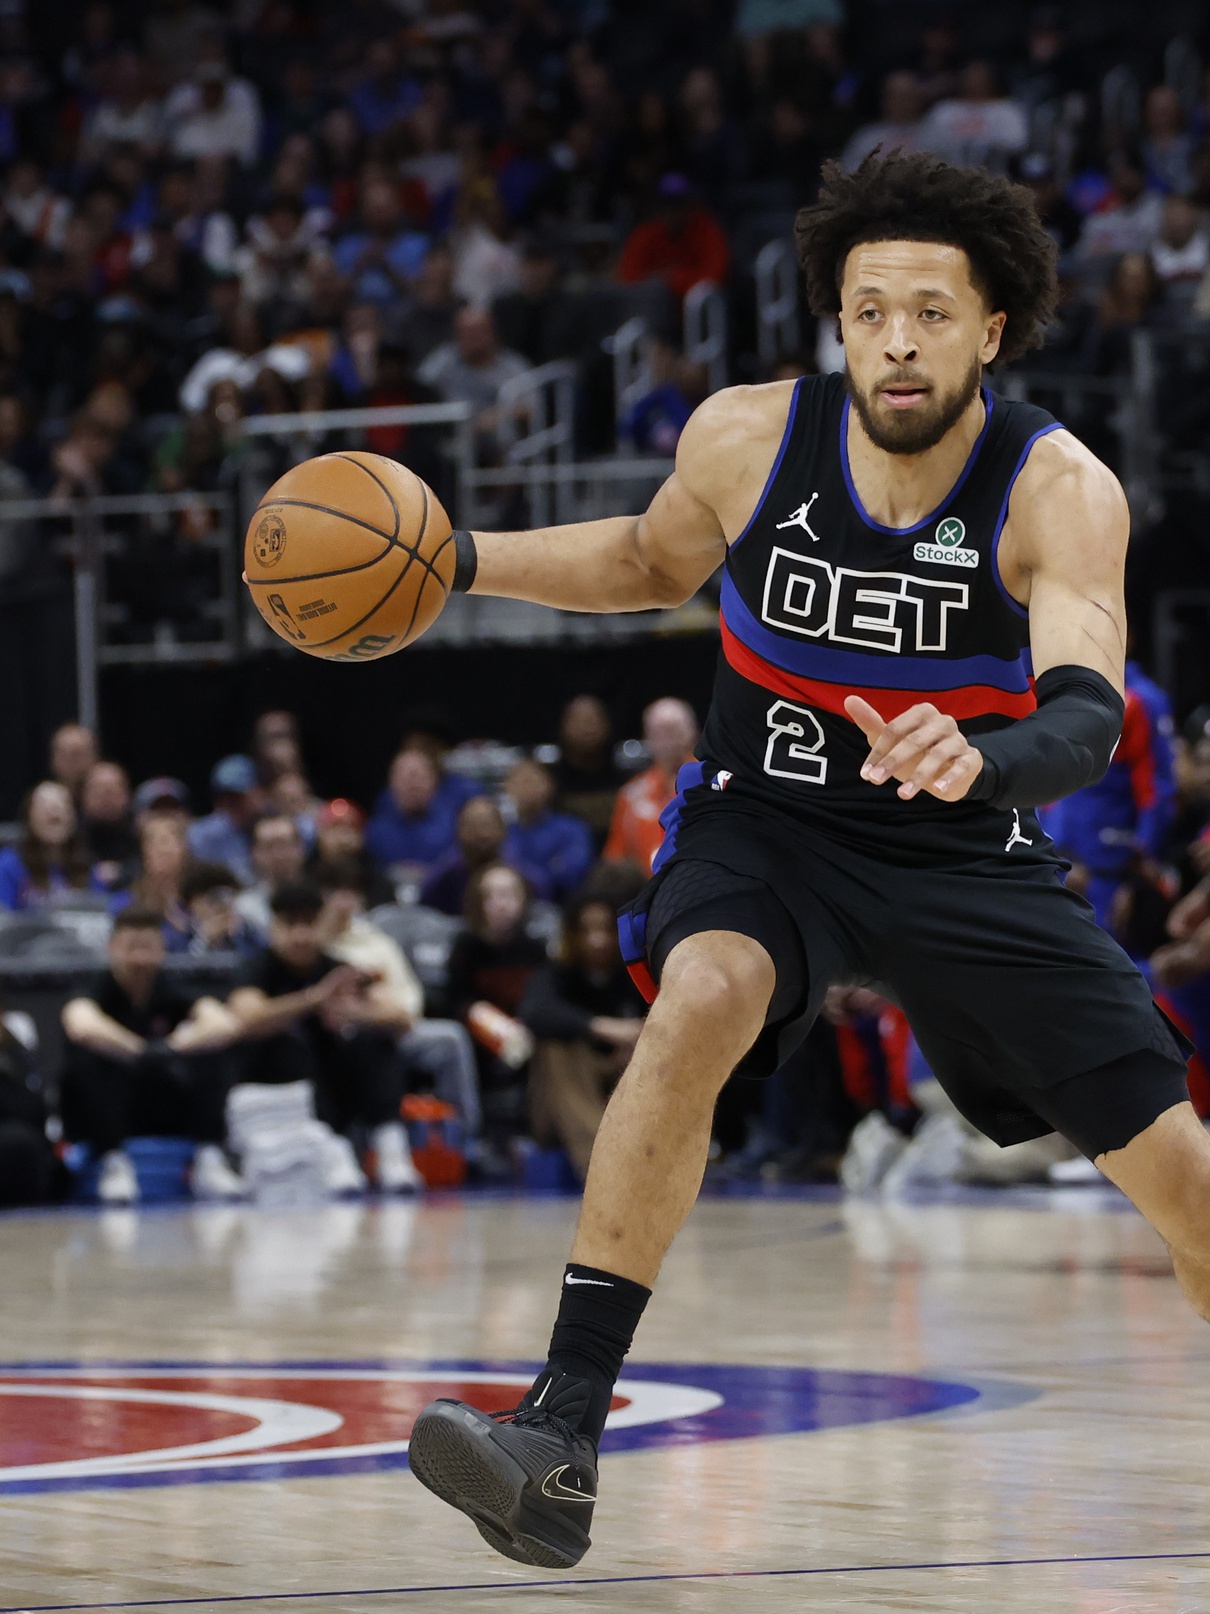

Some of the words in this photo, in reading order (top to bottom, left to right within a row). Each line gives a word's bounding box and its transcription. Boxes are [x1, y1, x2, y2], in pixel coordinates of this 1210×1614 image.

[915, 545, 976, 565] StockX
[762, 546, 969, 654] DET
[763, 699, 828, 785] 2
